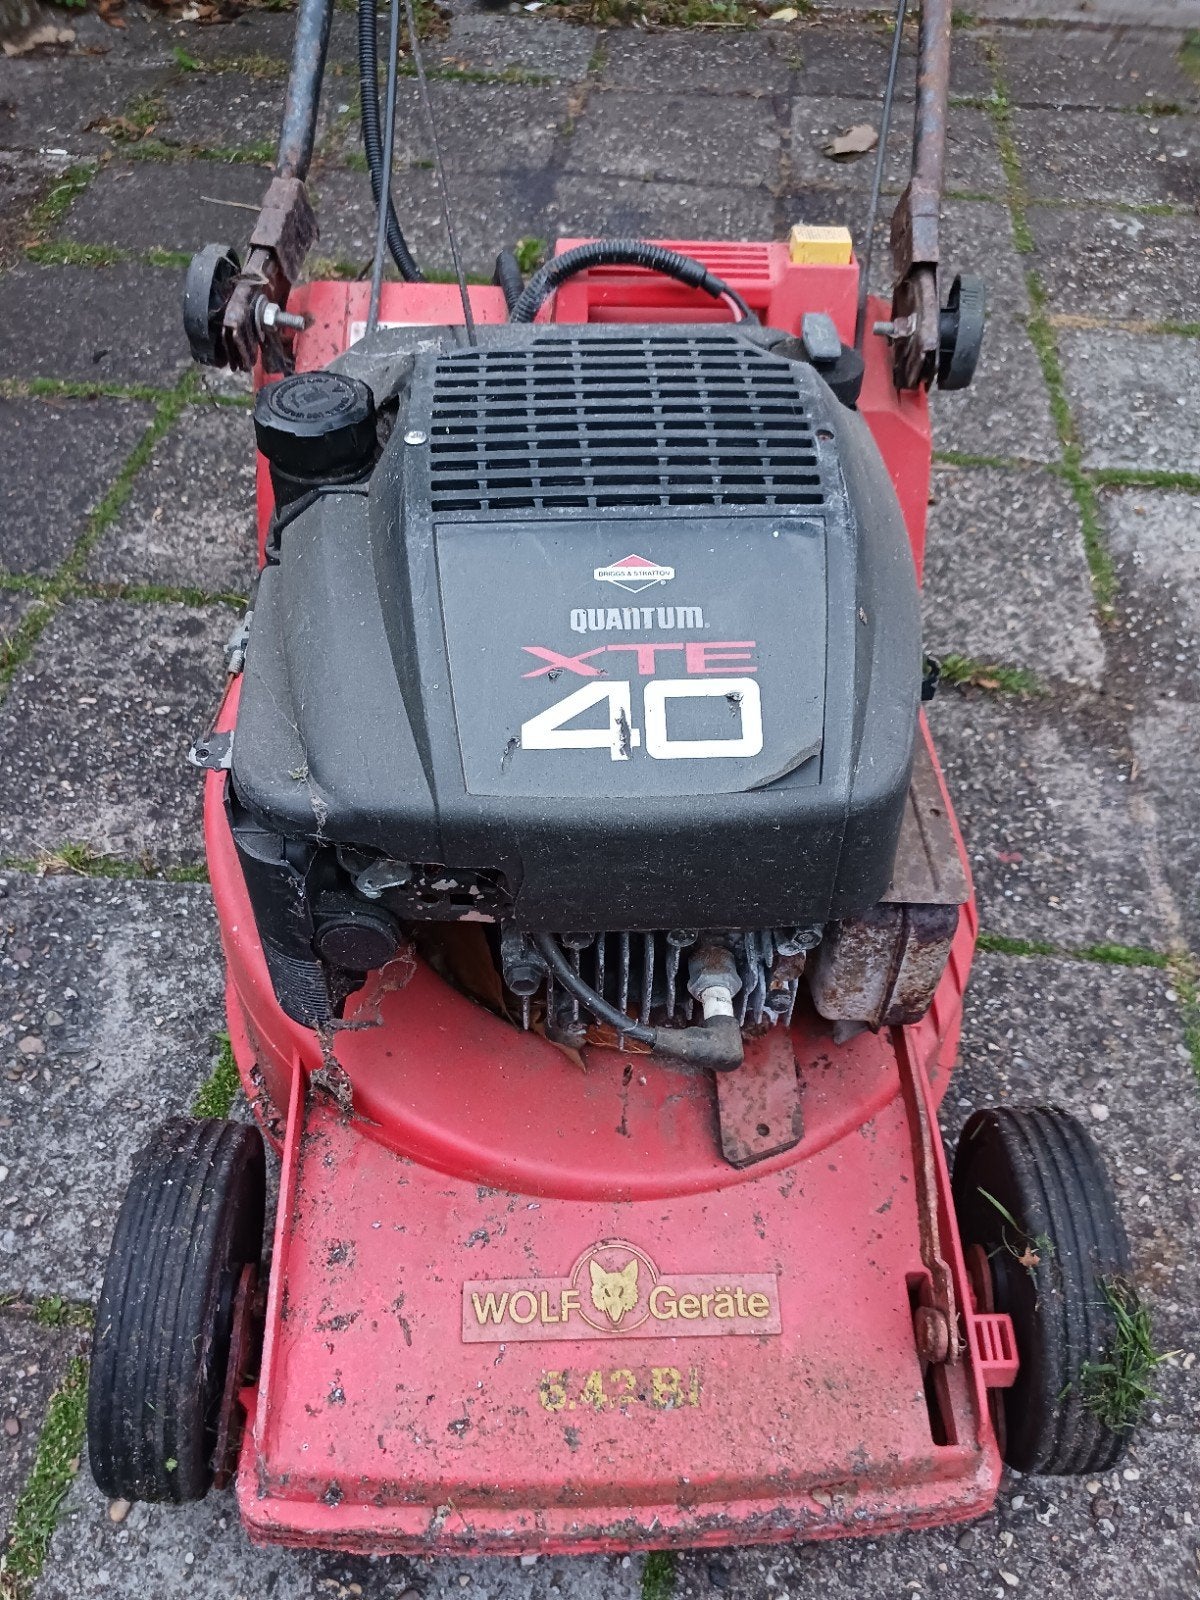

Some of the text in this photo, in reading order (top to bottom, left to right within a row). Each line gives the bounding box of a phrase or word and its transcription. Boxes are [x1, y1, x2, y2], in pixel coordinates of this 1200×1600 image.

[569, 605, 705, 633] QUANTUM
[520, 640, 758, 679] XTE
[520, 677, 764, 762] 40
[470, 1284, 771, 1325] WOLF Geräte
